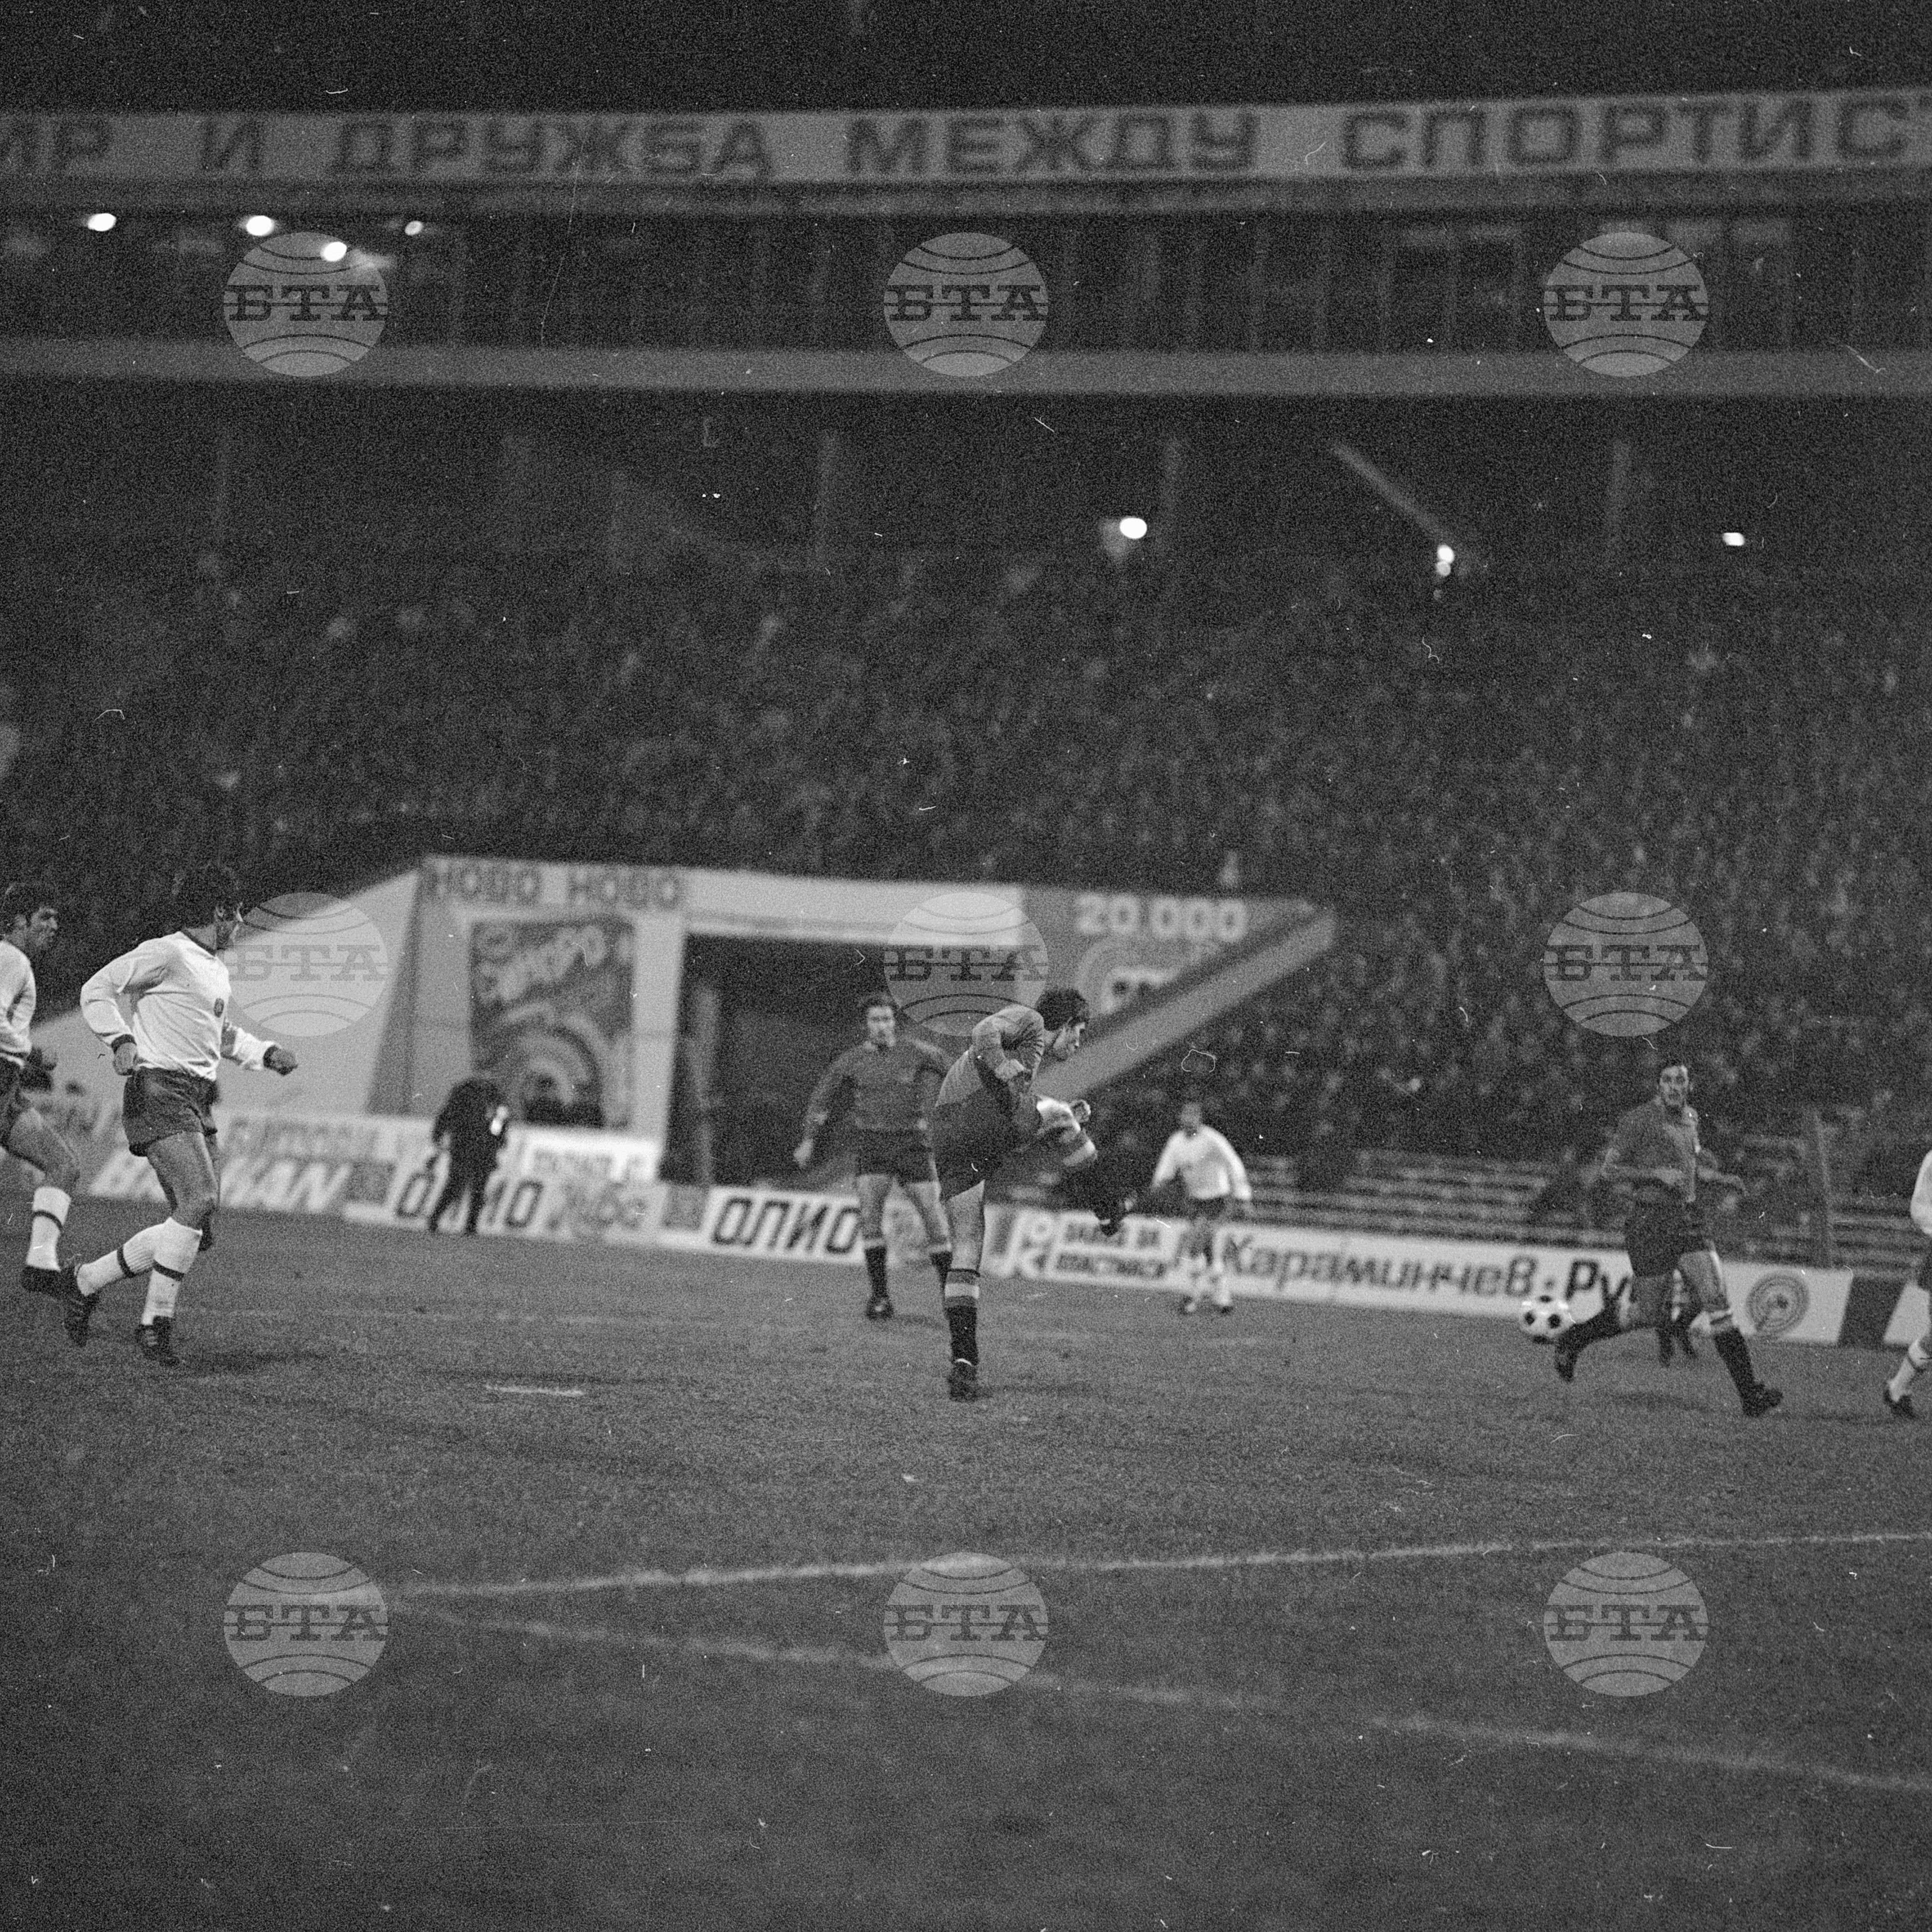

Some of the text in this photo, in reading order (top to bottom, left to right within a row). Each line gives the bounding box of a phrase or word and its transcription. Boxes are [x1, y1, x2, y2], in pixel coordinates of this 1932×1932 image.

[199, 119, 263, 173] И
[330, 119, 772, 175] ДРУЖБА
[847, 114, 1257, 174] МЕЖДУ
[1340, 96, 1932, 170] СПОРТИС
[1565, 1259, 1631, 1304] Ру
